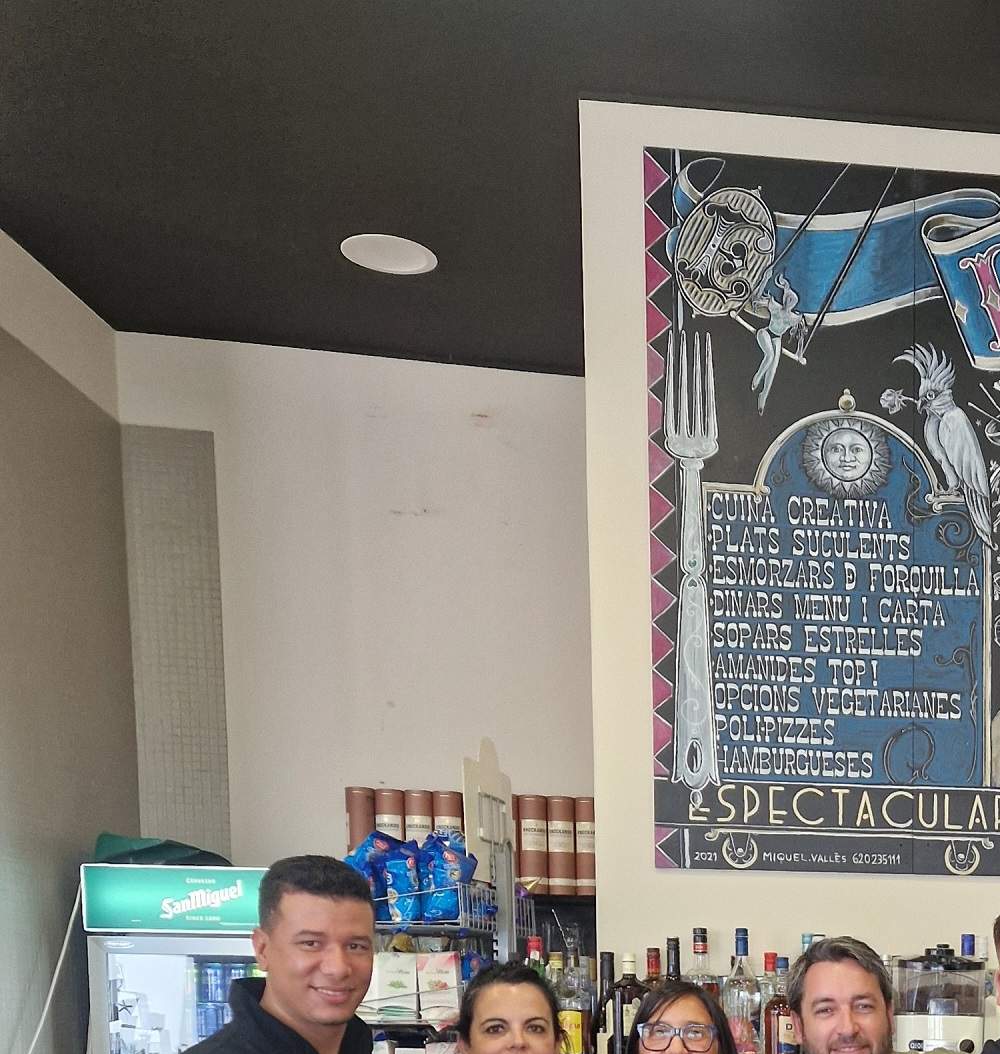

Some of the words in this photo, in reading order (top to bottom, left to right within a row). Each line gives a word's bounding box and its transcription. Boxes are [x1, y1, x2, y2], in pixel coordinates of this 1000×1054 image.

[711, 492, 775, 524] CUINA
[787, 495, 892, 529] CREATIVA
[711, 526, 780, 555] PLATS
[792, 529, 911, 561] SUCULENTS
[712, 555, 835, 590] ESMORZARS
[869, 563, 980, 599] FORQUILLA
[712, 589, 783, 620] DINARS
[793, 593, 851, 622] MENU
[861, 596, 868, 623] I
[879, 598, 946, 627] CARTA
[713, 622, 792, 651] SOPARS
[804, 625, 923, 656] ESTRELLES
[714, 653, 817, 684] AMANIDES
[714, 683, 801, 712] OPCIONS
[811, 687, 962, 720] VEGETARIANES
[693, 851, 718, 862] 2021
[852, 852, 901, 865] 620235111
